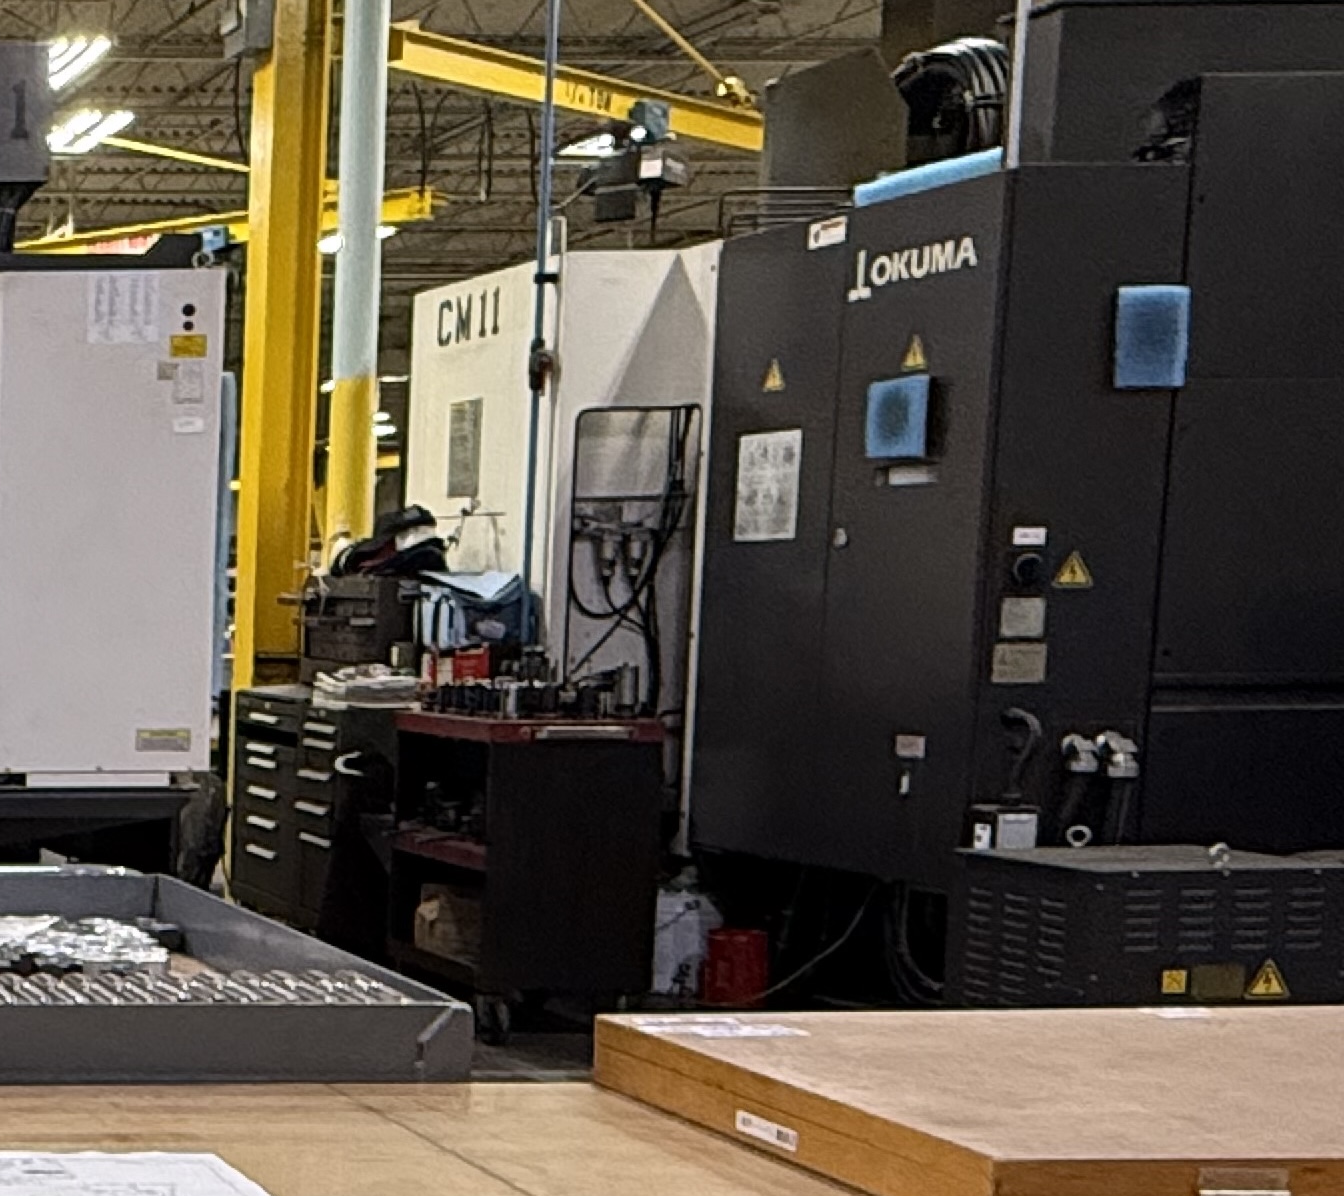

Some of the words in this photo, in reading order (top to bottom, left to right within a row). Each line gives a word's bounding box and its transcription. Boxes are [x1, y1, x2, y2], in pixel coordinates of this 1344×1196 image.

[9, 80, 31, 139] 1
[869, 236, 978, 287] OKUMA
[437, 293, 473, 348] CM
[477, 285, 502, 338] 11
